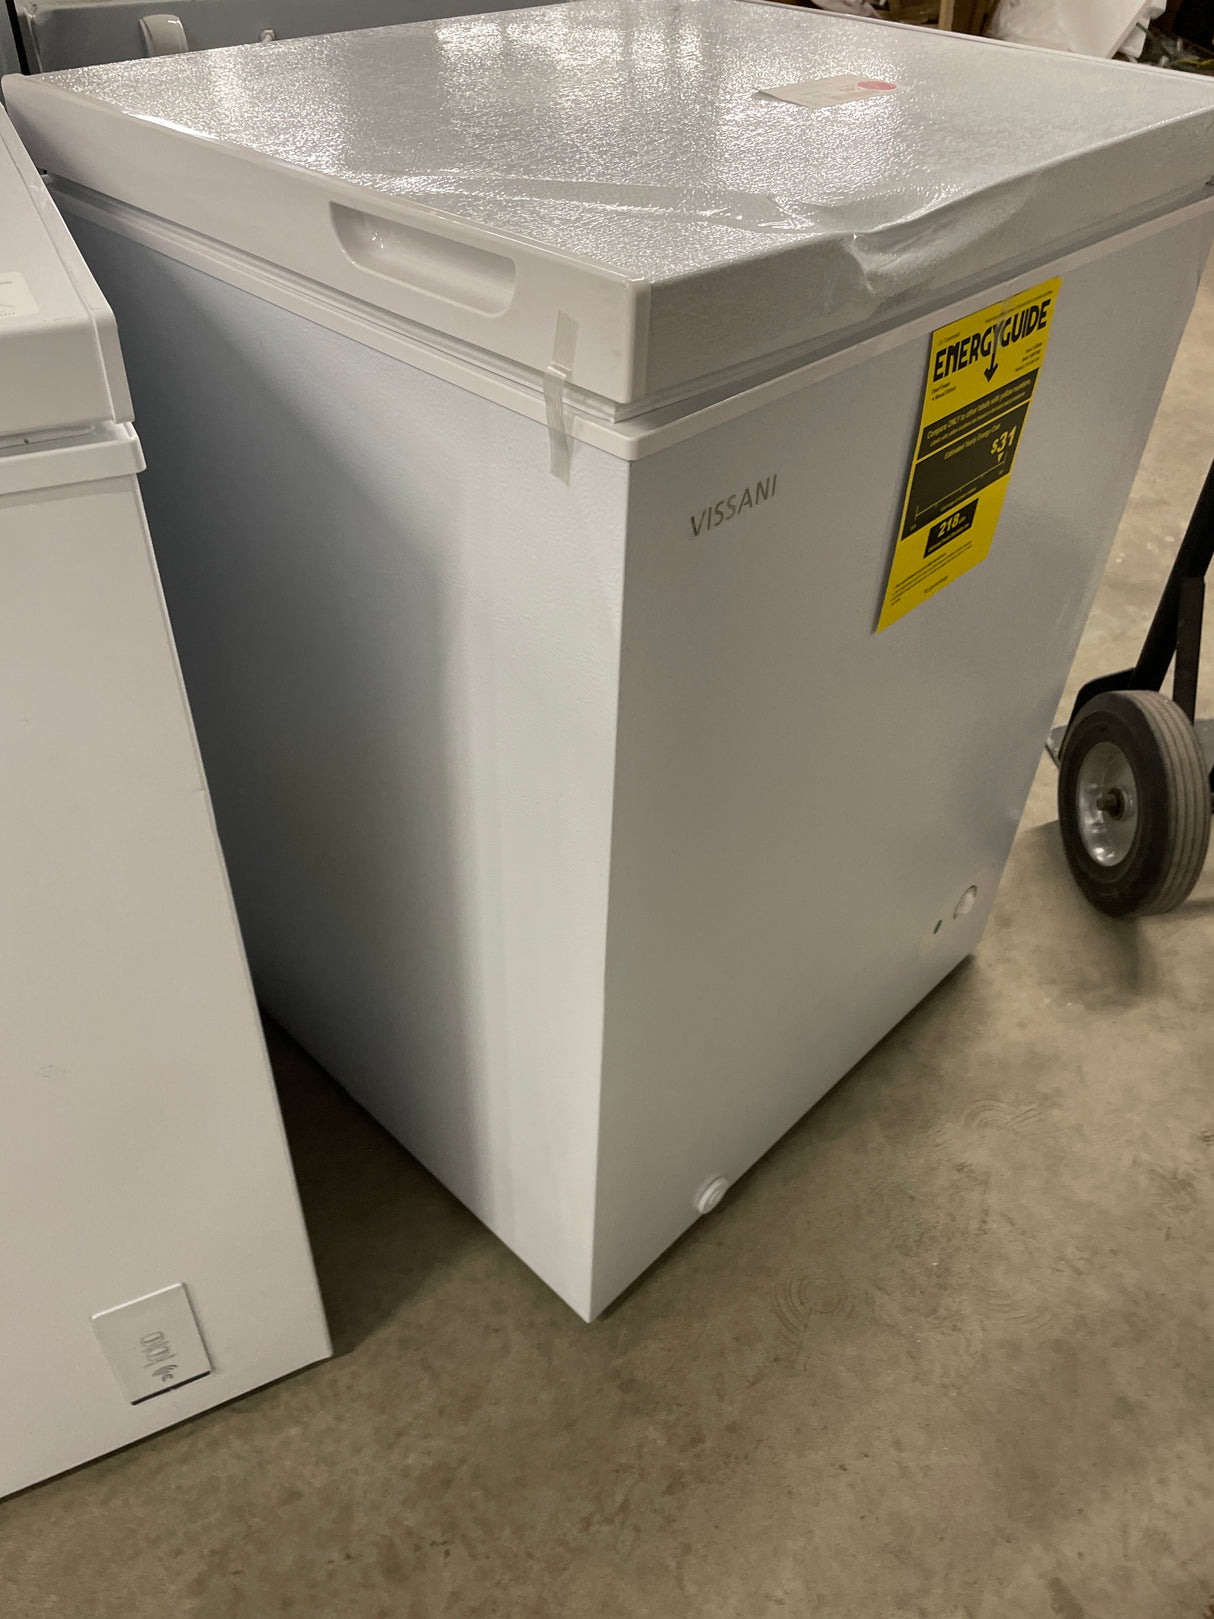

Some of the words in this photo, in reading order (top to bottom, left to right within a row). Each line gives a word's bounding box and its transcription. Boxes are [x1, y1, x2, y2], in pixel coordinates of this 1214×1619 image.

[932, 298, 1052, 382] ENERGYGUIDE
[990, 426, 1017, 454] $31
[690, 473, 777, 537] VISSANI
[937, 513, 960, 538] 218
